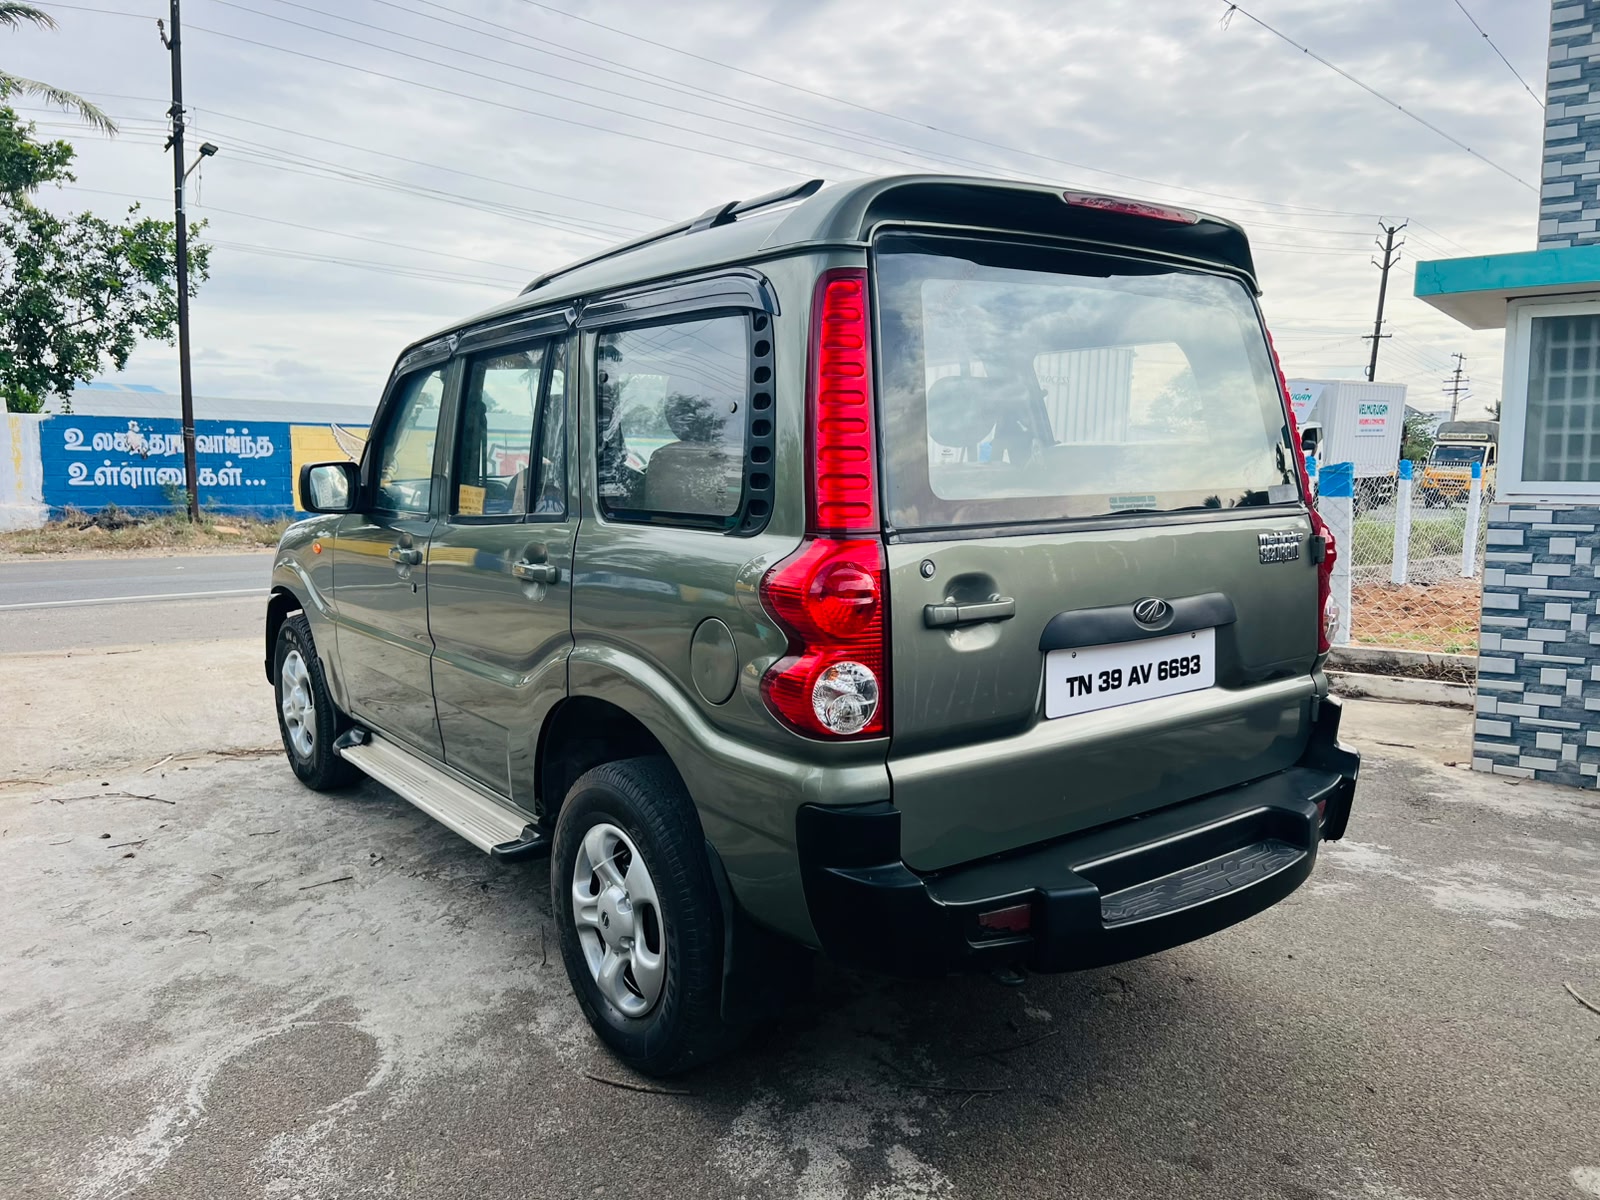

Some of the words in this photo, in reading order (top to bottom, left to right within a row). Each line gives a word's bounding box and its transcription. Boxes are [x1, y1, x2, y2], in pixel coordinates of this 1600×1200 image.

[1066, 675, 1092, 697] TN
[1098, 669, 1123, 692] 39
[1128, 663, 1153, 686] AV
[1158, 655, 1201, 681] 6693
